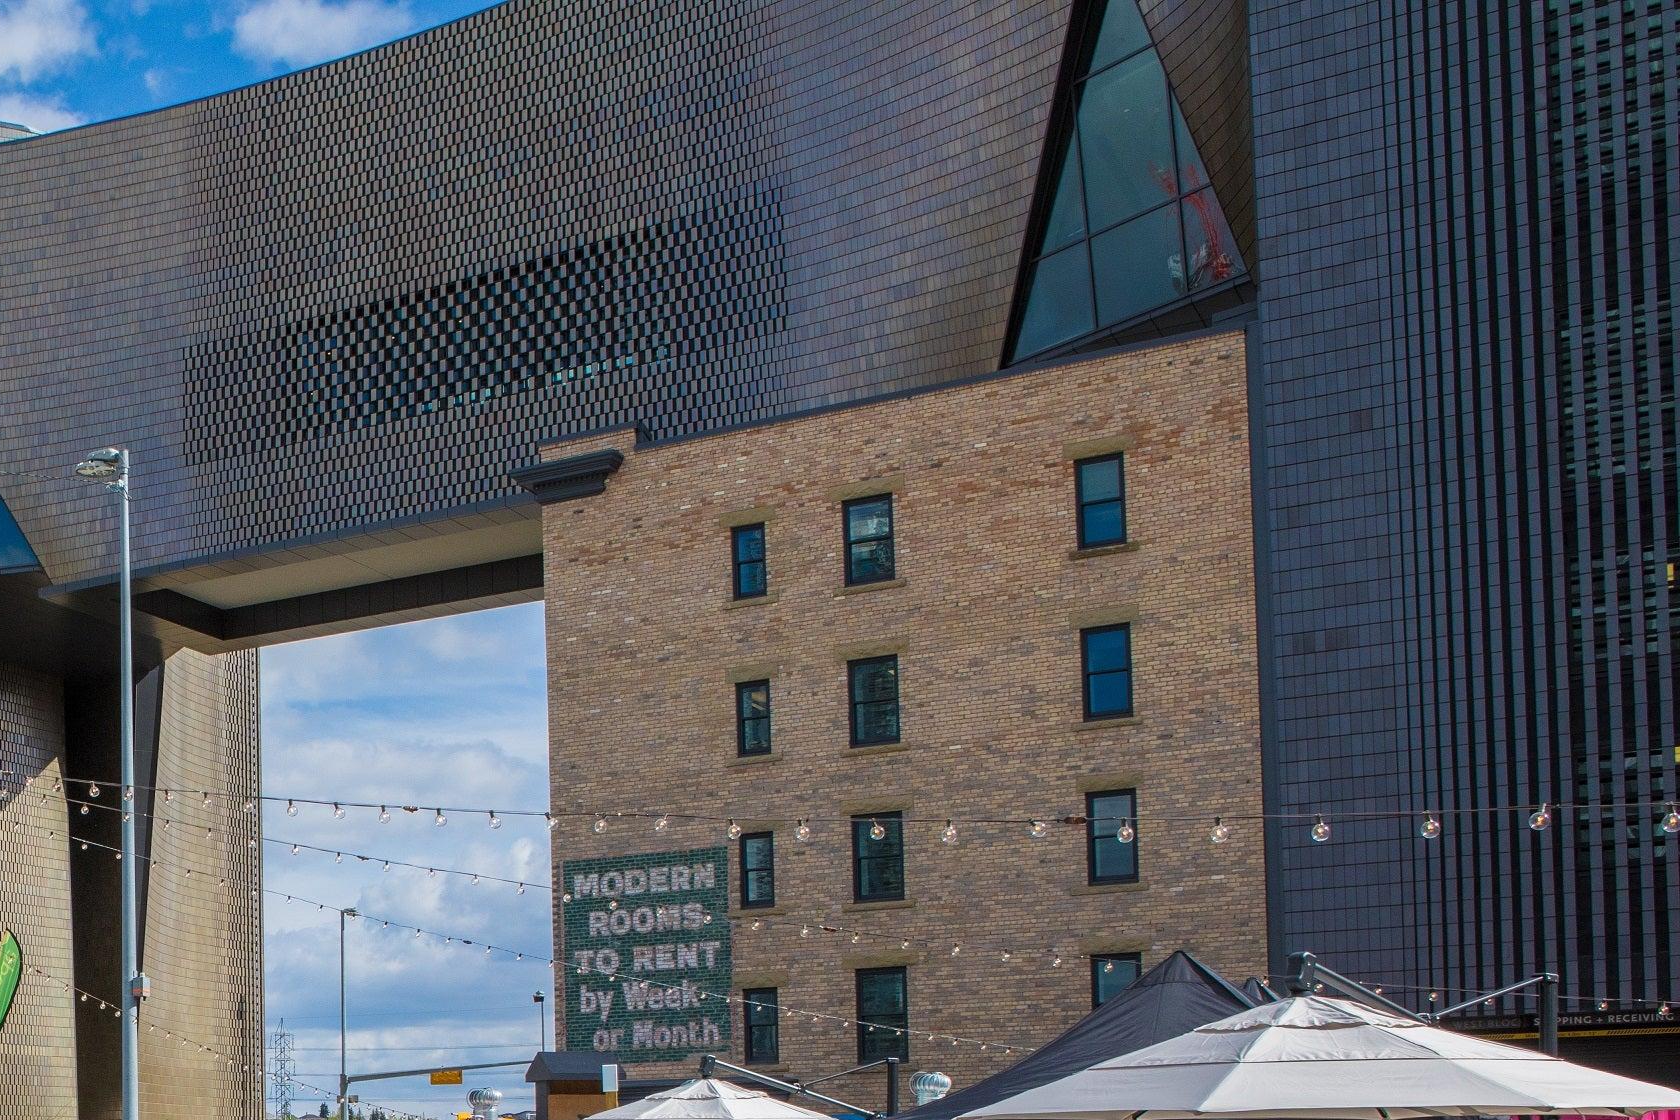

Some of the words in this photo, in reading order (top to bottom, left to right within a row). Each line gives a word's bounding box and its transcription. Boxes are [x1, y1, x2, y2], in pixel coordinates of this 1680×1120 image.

[573, 862, 715, 899] MODERN
[589, 902, 706, 937] ROOMS
[575, 949, 619, 975] TO
[633, 941, 720, 973] RENT
[580, 985, 614, 1024] by
[622, 979, 701, 1011] Week
[1534, 1015, 1592, 1026] SPPING
[1608, 1012, 1675, 1023] RECEIVING
[593, 1028, 624, 1052] or
[633, 1016, 720, 1049] Month
